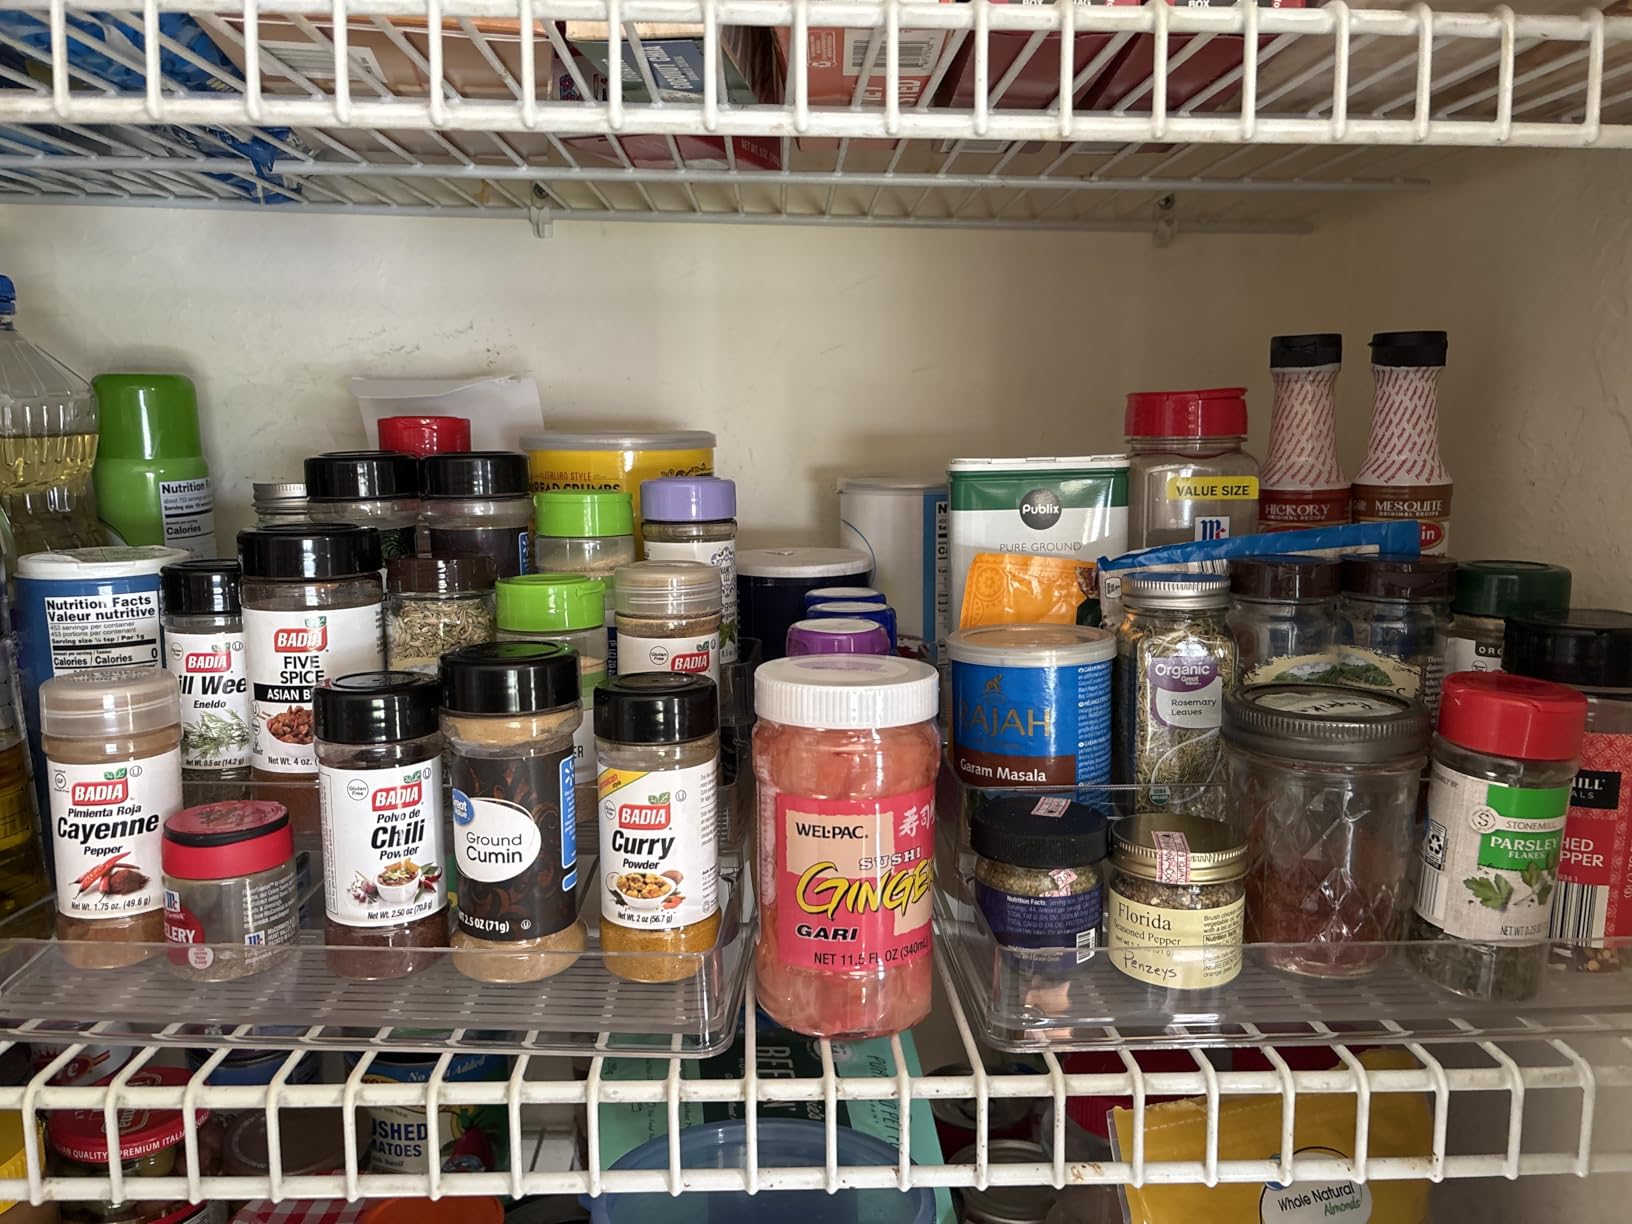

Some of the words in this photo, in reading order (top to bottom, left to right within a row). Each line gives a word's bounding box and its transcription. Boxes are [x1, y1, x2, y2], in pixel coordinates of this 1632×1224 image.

[570, 471, 592, 481] STYLE
[161, 482, 205, 494] Nutrition
[1176, 486, 1218, 496] VALUE
[1221, 485, 1250, 496] SIZE
[1022, 503, 1060, 515] Publix
[1265, 504, 1330, 515] HICKORY
[1375, 500, 1442, 511] MESQUITE
[166, 525, 201, 535] Calories
[1000, 543, 1027, 552] PURE
[1031, 541, 1082, 552] GROUND
[47, 598, 106, 610] Nutrition
[113, 594, 152, 608] Facts
[48, 611, 91, 622] Valeur
[96, 607, 156, 621] nutritive
[54, 657, 88, 667] Calories
[95, 654, 133, 665] Calories
[151, 647, 158, 659] 0
[188, 655, 228, 669] BADIA
[284, 655, 320, 669] FIVE
[674, 654, 708, 670] BADIA
[280, 670, 325, 684] SPICE
[1155, 663, 1211, 679] Organic
[178, 674, 195, 695] ill
[201, 675, 247, 695] Wee
[267, 689, 299, 700] ASIAN
[193, 700, 227, 709] Eneldo
[1171, 698, 1217, 707] Rosemary
[1171, 708, 1203, 716] Leaves
[268, 756, 279, 764] Net
[960, 758, 993, 778] Garam
[997, 766, 1047, 782] Masala
[74, 784, 123, 801] BADIA
[375, 786, 419, 807] BADIA
[68, 808, 113, 819] Pimienta
[116, 804, 142, 818] Roja
[377, 812, 407, 824] Polvo
[408, 809, 421, 820] de
[620, 808, 667, 825] BADIA
[57, 814, 160, 844] Cayenne
[371, 818, 426, 850] Chili
[466, 831, 523, 847] Ground
[611, 829, 676, 860] Curry
[84, 845, 124, 858] Pepper
[379, 845, 420, 861] Powder
[466, 845, 523, 863] Cumin
[859, 847, 921, 871] SUSHI
[1508, 849, 1547, 860] FLAKES
[622, 858, 660, 870] Powder
[1560, 851, 1604, 868] PPER
[71, 901, 80, 910] Net
[94, 901, 109, 911] 1.75
[110, 901, 121, 910] oz.
[1007, 895, 1030, 905] Nutrition
[367, 911, 379, 920] Net
[391, 908, 405, 918] 2.50
[406, 907, 414, 915] oz
[636, 914, 641, 922] 2
[641, 915, 649, 923] oz
[1117, 902, 1172, 931] Florida
[164, 922, 197, 944] ELERY
[796, 923, 859, 942] GARI
[1147, 932, 1182, 947] Pepper
[814, 951, 837, 965] NET
[841, 953, 864, 966] 11.5
[869, 952, 879, 964] FL
[885, 948, 898, 962] OZ
[1122, 950, 1177, 981] Penzeys
[408, 1071, 426, 1081] No
[457, 1055, 485, 1074] Added
[72, 1149, 108, 1160] QUALITY
[119, 1140, 161, 1157] PREMIUM
[1277, 1194, 1312, 1212] Whole
[1311, 1181, 1355, 1203] Natural
[1324, 1196, 1361, 1217] Almonds
